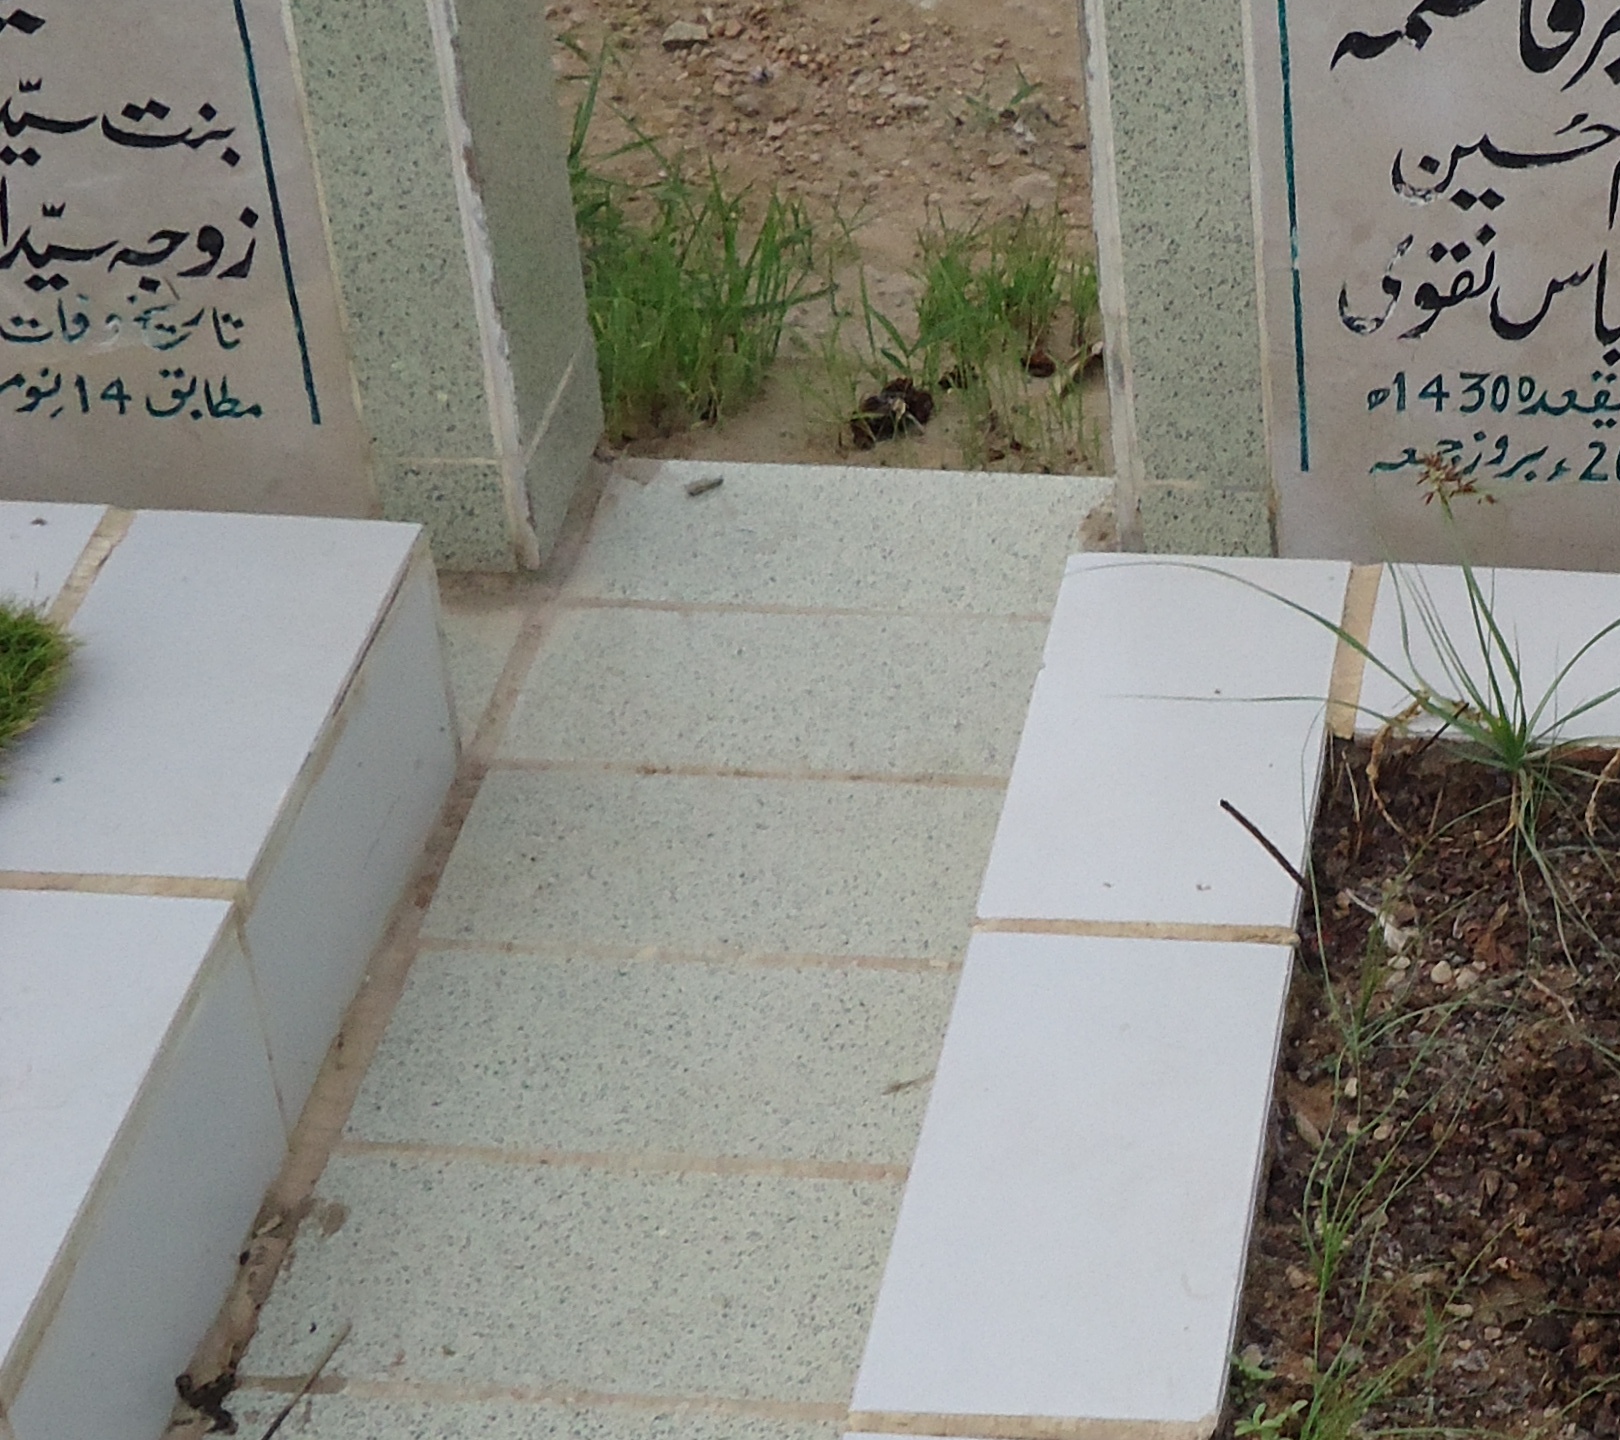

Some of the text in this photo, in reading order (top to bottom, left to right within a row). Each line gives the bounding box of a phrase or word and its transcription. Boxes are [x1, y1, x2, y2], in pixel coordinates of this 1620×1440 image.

[101, 98, 241, 168] بنت
[107, 206, 259, 292] زوجہ
[1338, 225, 1497, 340] نقوی
[145, 367, 264, 421] مطابق
